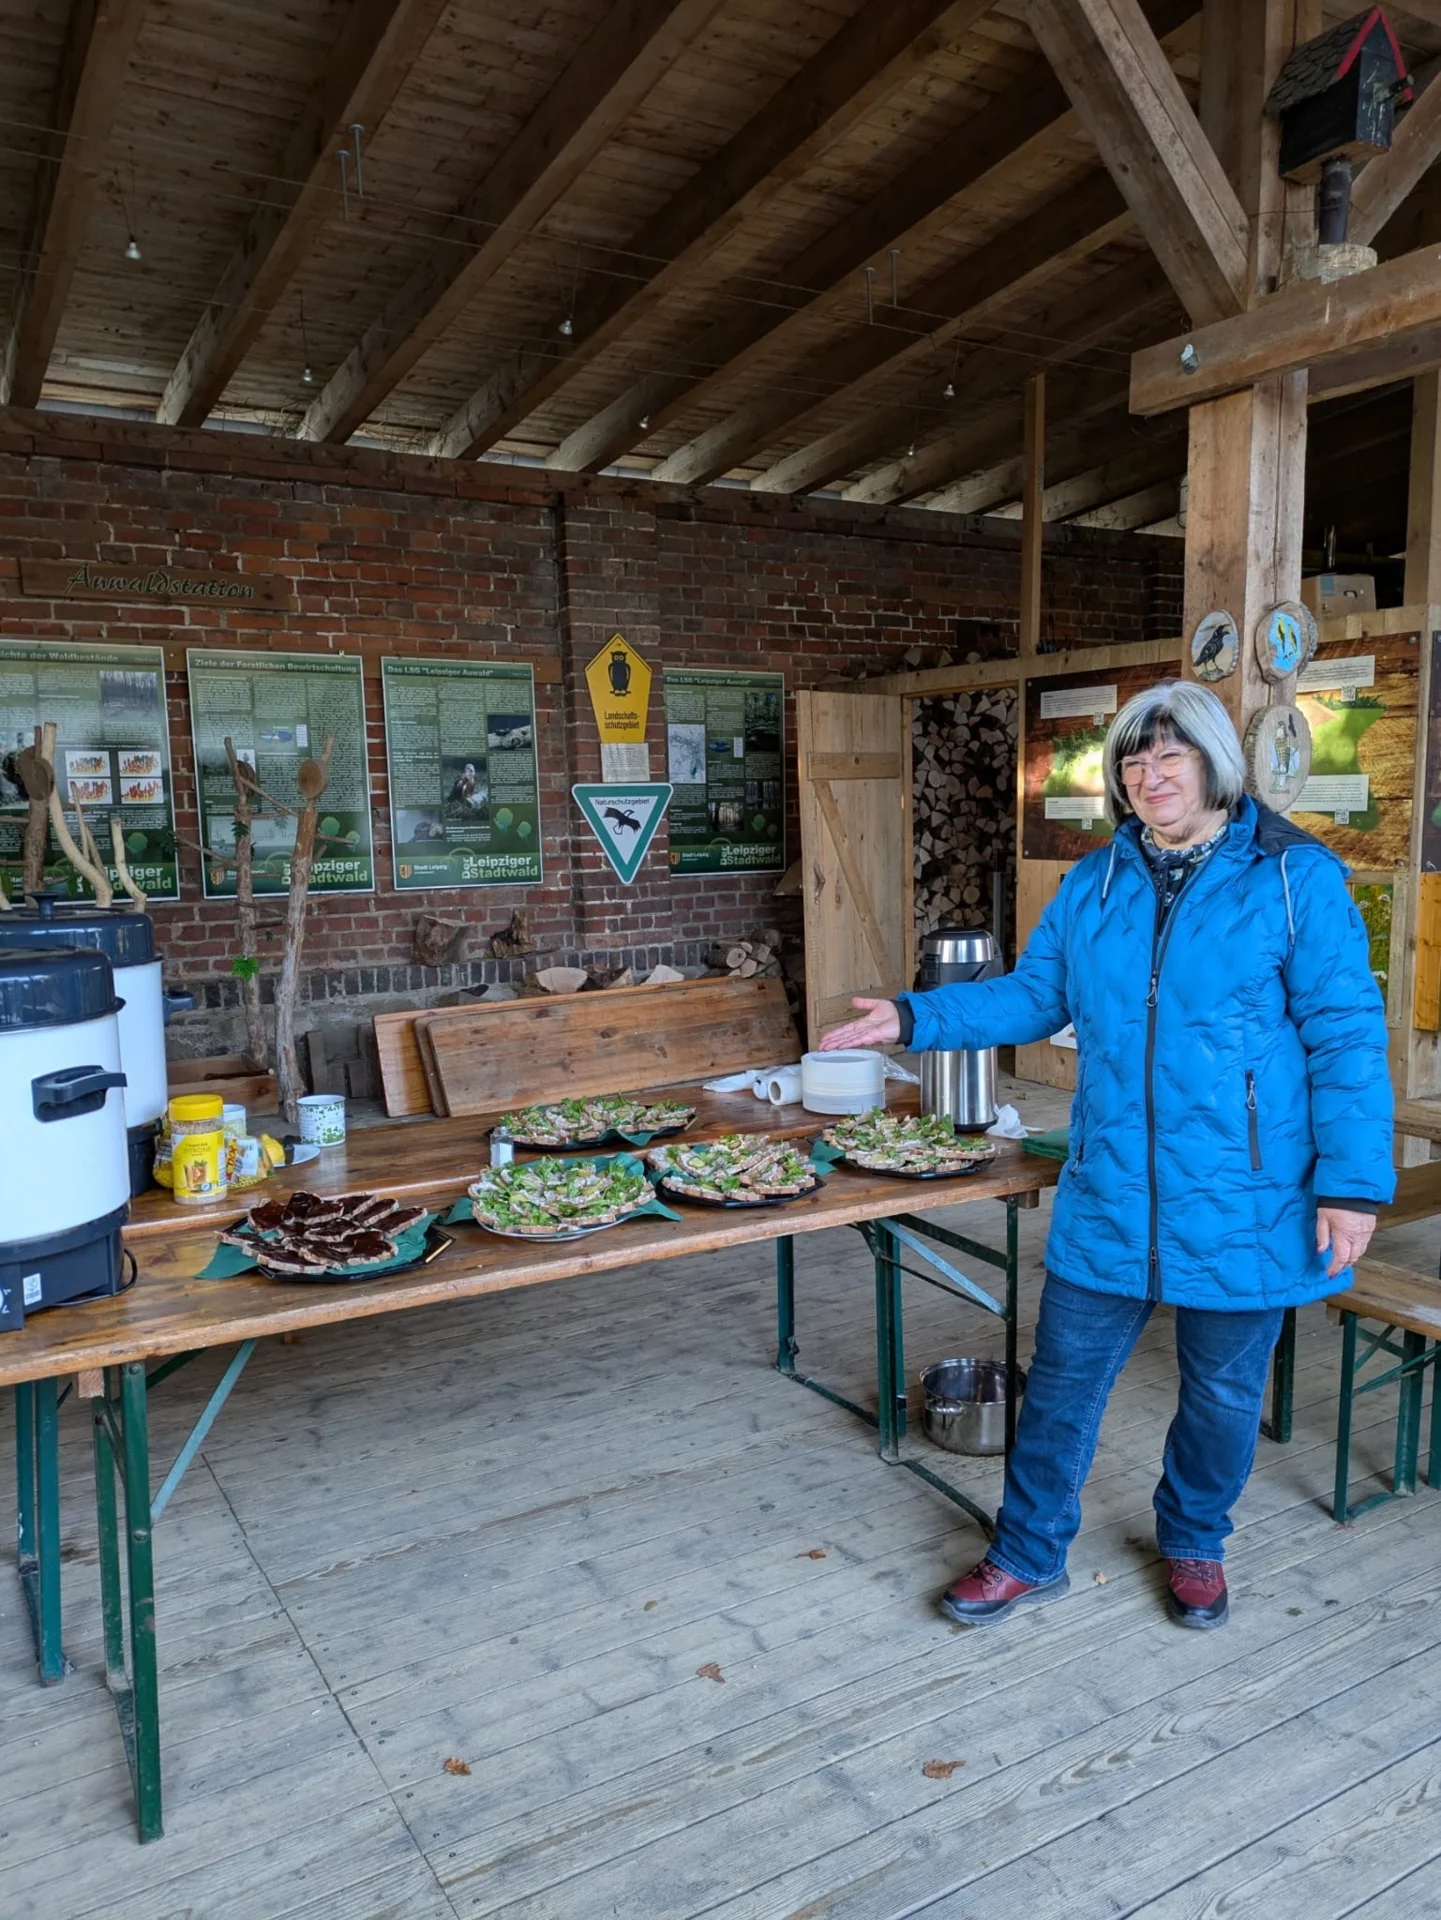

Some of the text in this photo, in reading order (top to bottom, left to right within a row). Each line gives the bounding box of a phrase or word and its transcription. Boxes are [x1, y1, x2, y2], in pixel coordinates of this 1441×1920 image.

[30, 651, 47, 661] der
[49, 651, 119, 663] Waldbestände
[194, 658, 357, 674] Ziele der Forstlichen Bewirtschaftung
[387, 665, 403, 674] Das
[404, 665, 421, 674] LSG
[604, 711, 640, 721] Landschafts-
[604, 721, 640, 731] schutzgebiet
[594, 798, 651, 807] Naturschutzgebiet
[726, 844, 777, 859] Leipziger
[726, 852, 781, 866] Stadtwald
[311, 859, 361, 875] pziger
[428, 863, 448, 871] Leipzig
[461, 857, 471, 879] Der
[469, 854, 532, 869] Leipziger
[281, 861, 292, 885] Der
[308, 870, 368, 885] adtwald
[470, 864, 539, 879] Stadtwald
